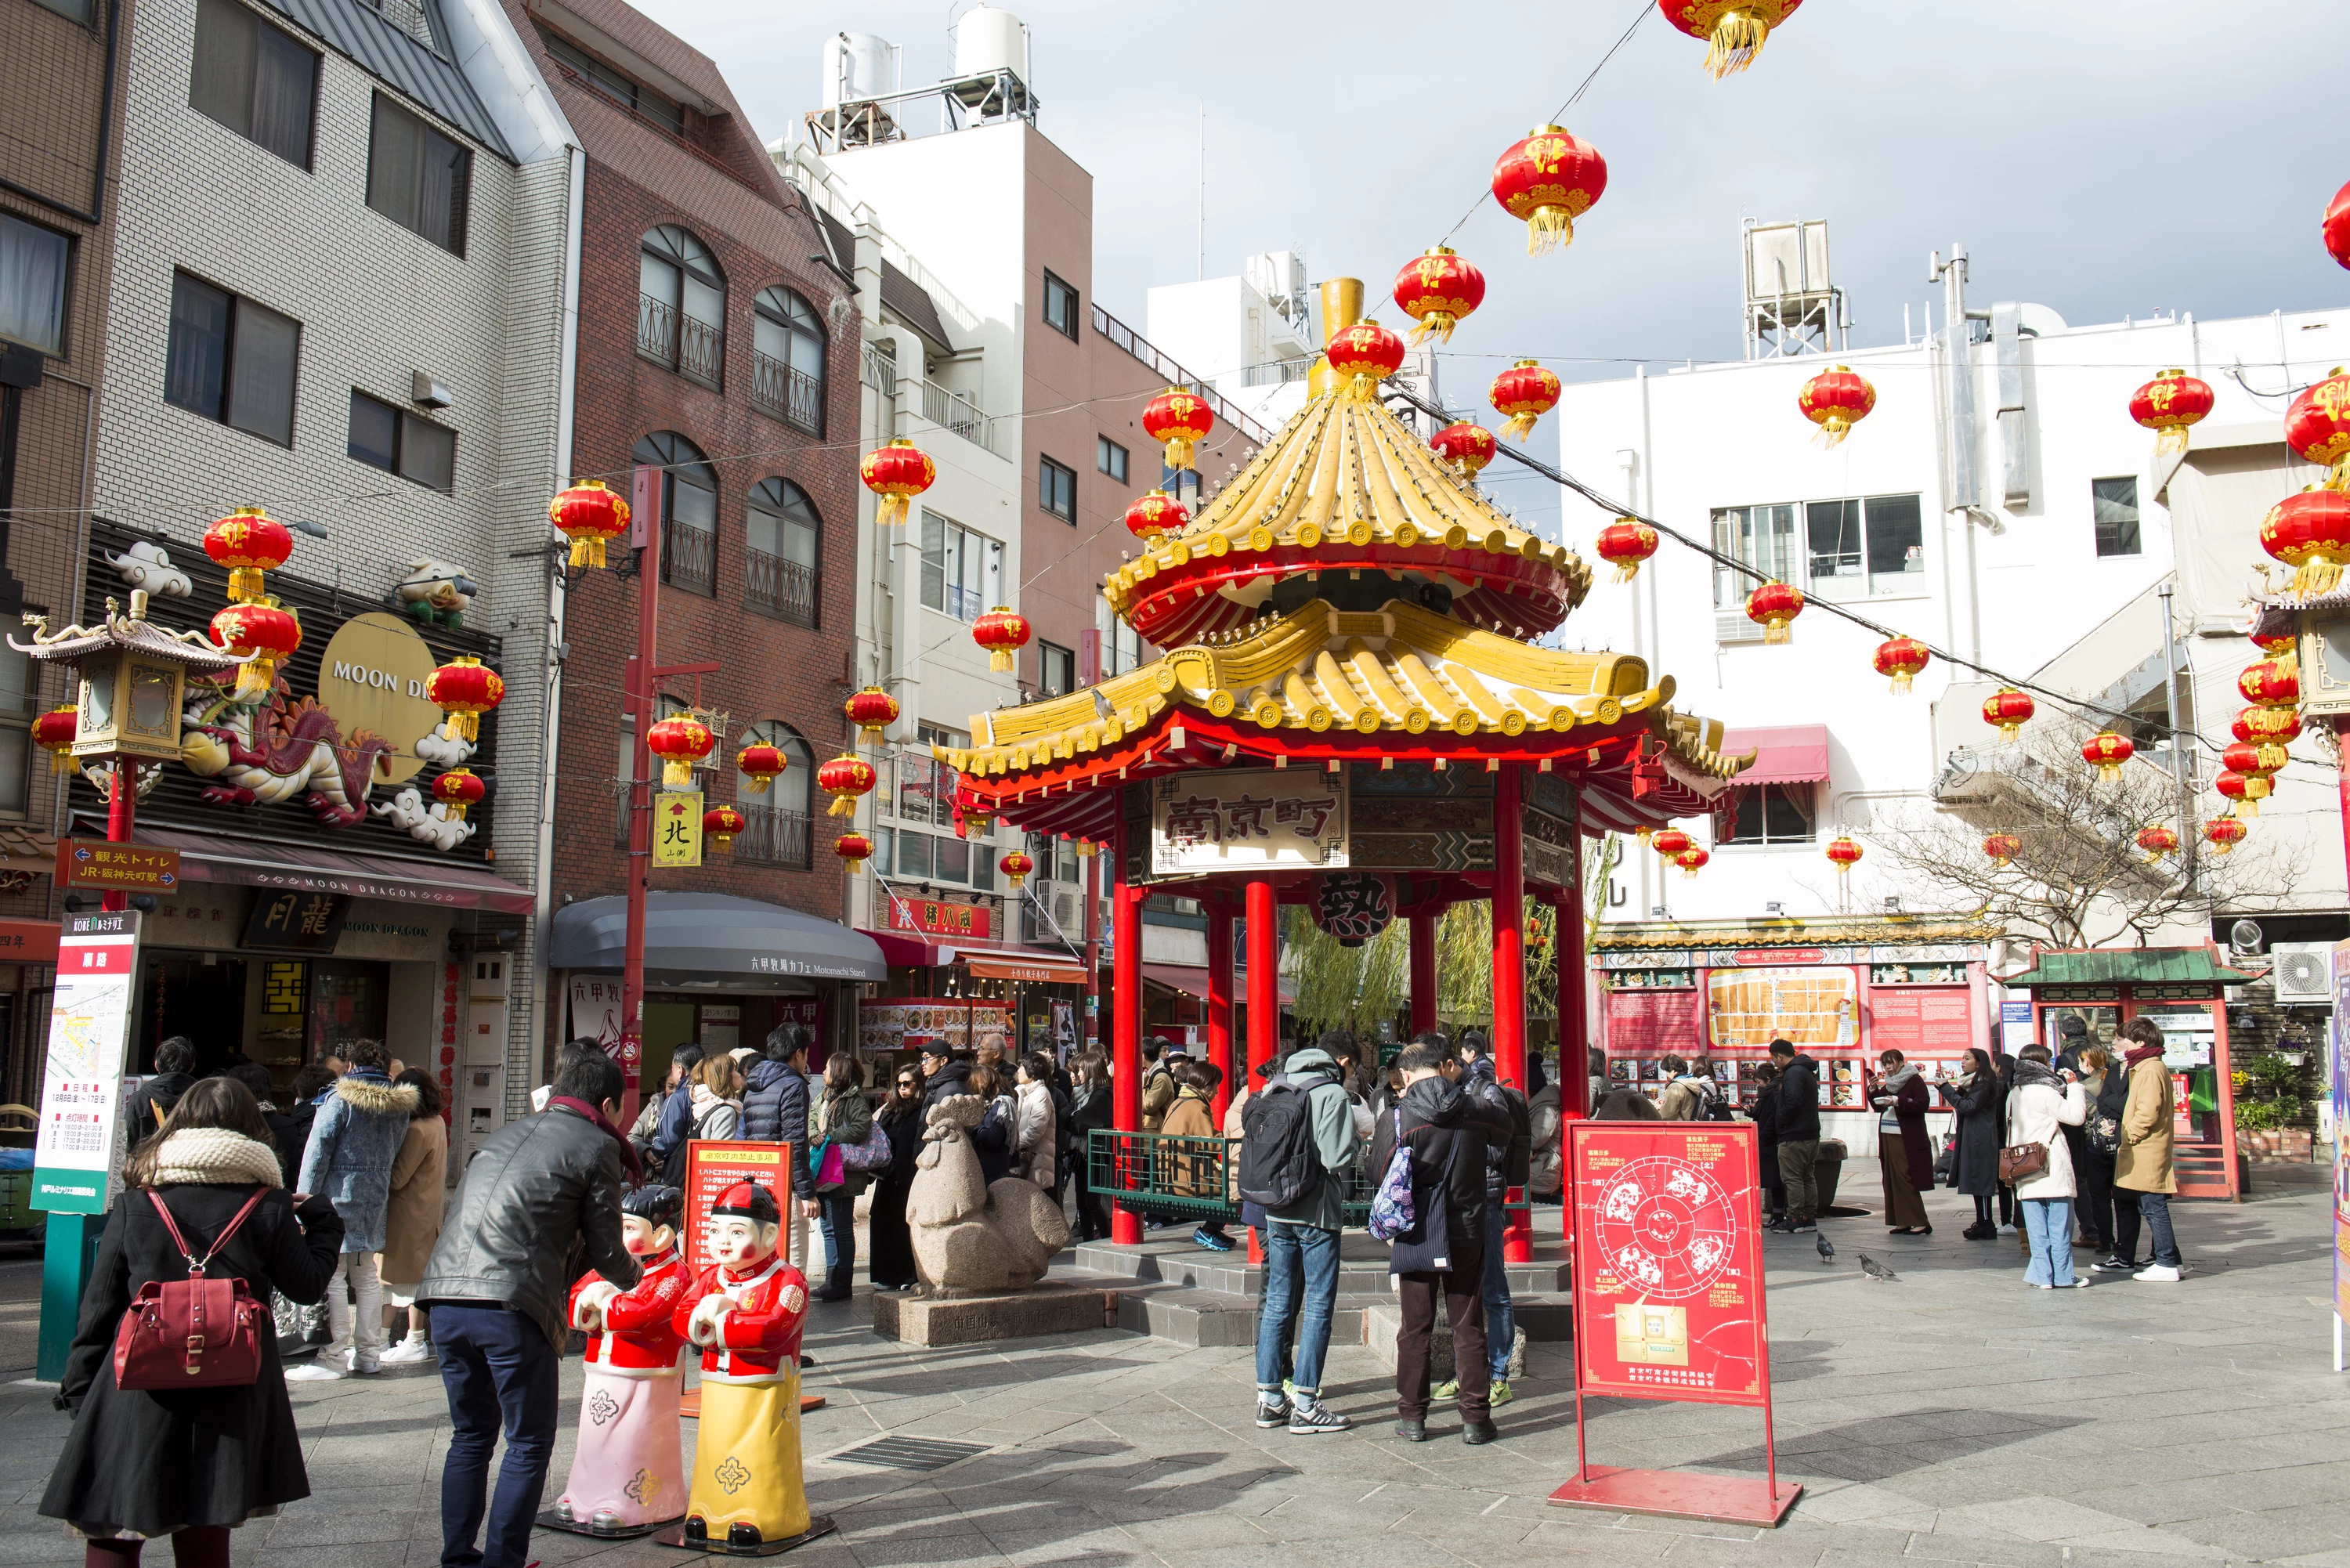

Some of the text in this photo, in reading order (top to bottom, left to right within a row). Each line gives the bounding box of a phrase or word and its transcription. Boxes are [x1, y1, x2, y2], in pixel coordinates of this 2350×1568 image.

[333, 660, 397, 692] MOON
[1164, 793, 1338, 844] 南京町
[663, 819, 690, 845] 北
[95, 851, 169, 867] 観光トイレ
[306, 878, 417, 899] MOON DRAGON
[924, 903, 971, 928] 猪八戒
[74, 919, 124, 932] KOBE ルミナリエ
[345, 921, 430, 938] MOON DRAGON
[82, 952, 107, 967] 順路
[751, 956, 866, 977] 六甲牧場カフェ Motomachi Stand
[574, 981, 620, 1003] 六甲牧
[782, 1003, 816, 1021] 六甲
[705, 1152, 773, 1162] 南京町内禁止事項
[1629, 1367, 1714, 1378] 南京町商店街振興組合
[1629, 1375, 1714, 1386] 南京町景観形成協議会
